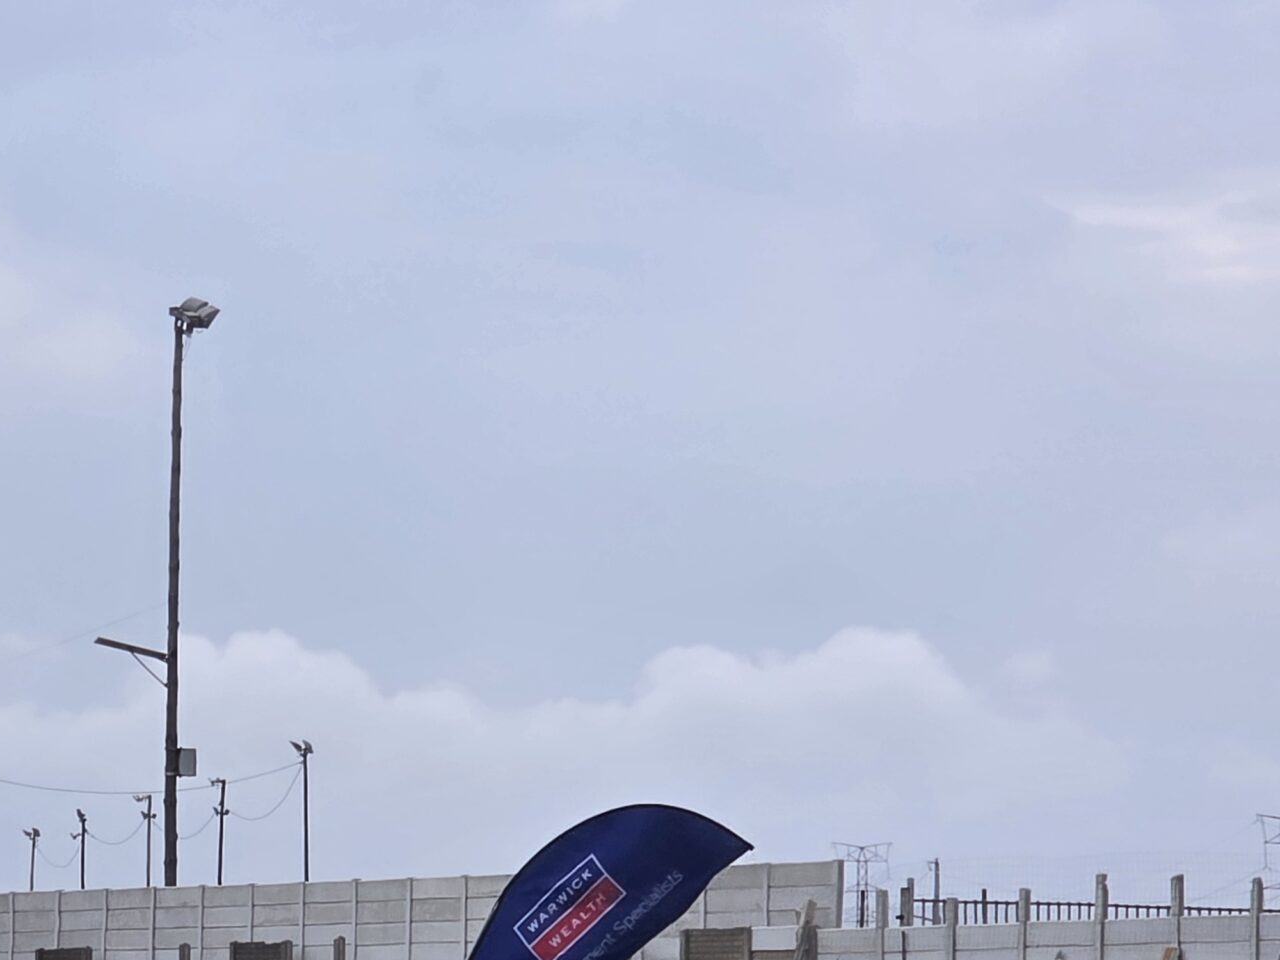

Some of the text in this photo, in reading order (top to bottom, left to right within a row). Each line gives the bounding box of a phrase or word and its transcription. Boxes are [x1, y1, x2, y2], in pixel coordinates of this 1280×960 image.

[527, 868, 593, 933] WARWICK
[548, 893, 606, 948] WEALTH
[613, 869, 684, 936] Specialists
